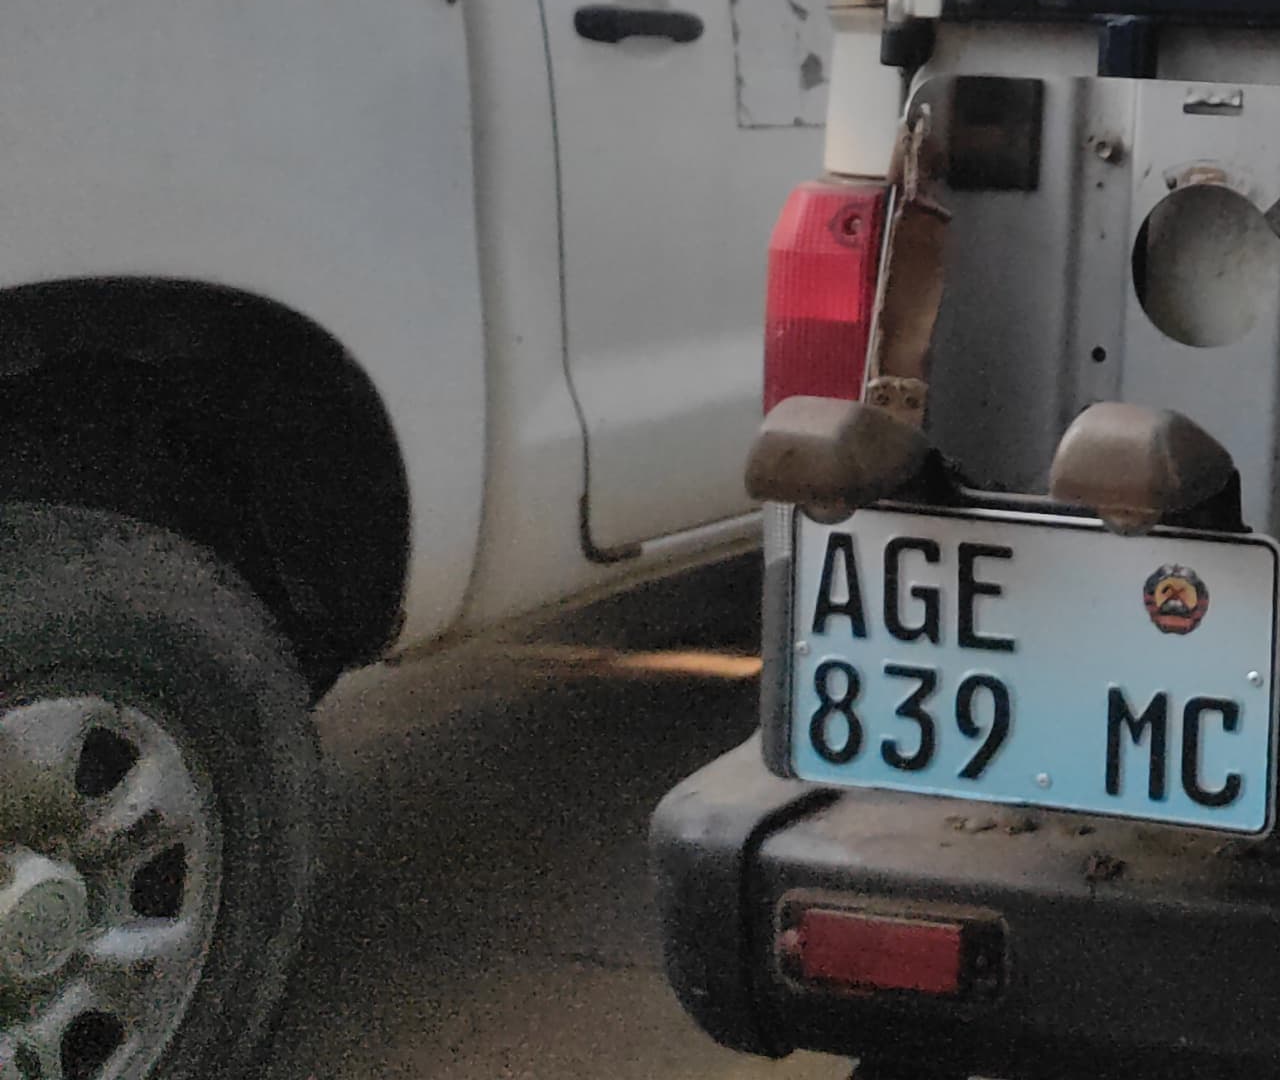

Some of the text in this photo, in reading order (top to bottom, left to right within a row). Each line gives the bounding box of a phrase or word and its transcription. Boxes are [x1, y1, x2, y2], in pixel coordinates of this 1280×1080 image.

[811, 531, 1016, 653] AGE
[808, 658, 1243, 808] 839 MC
